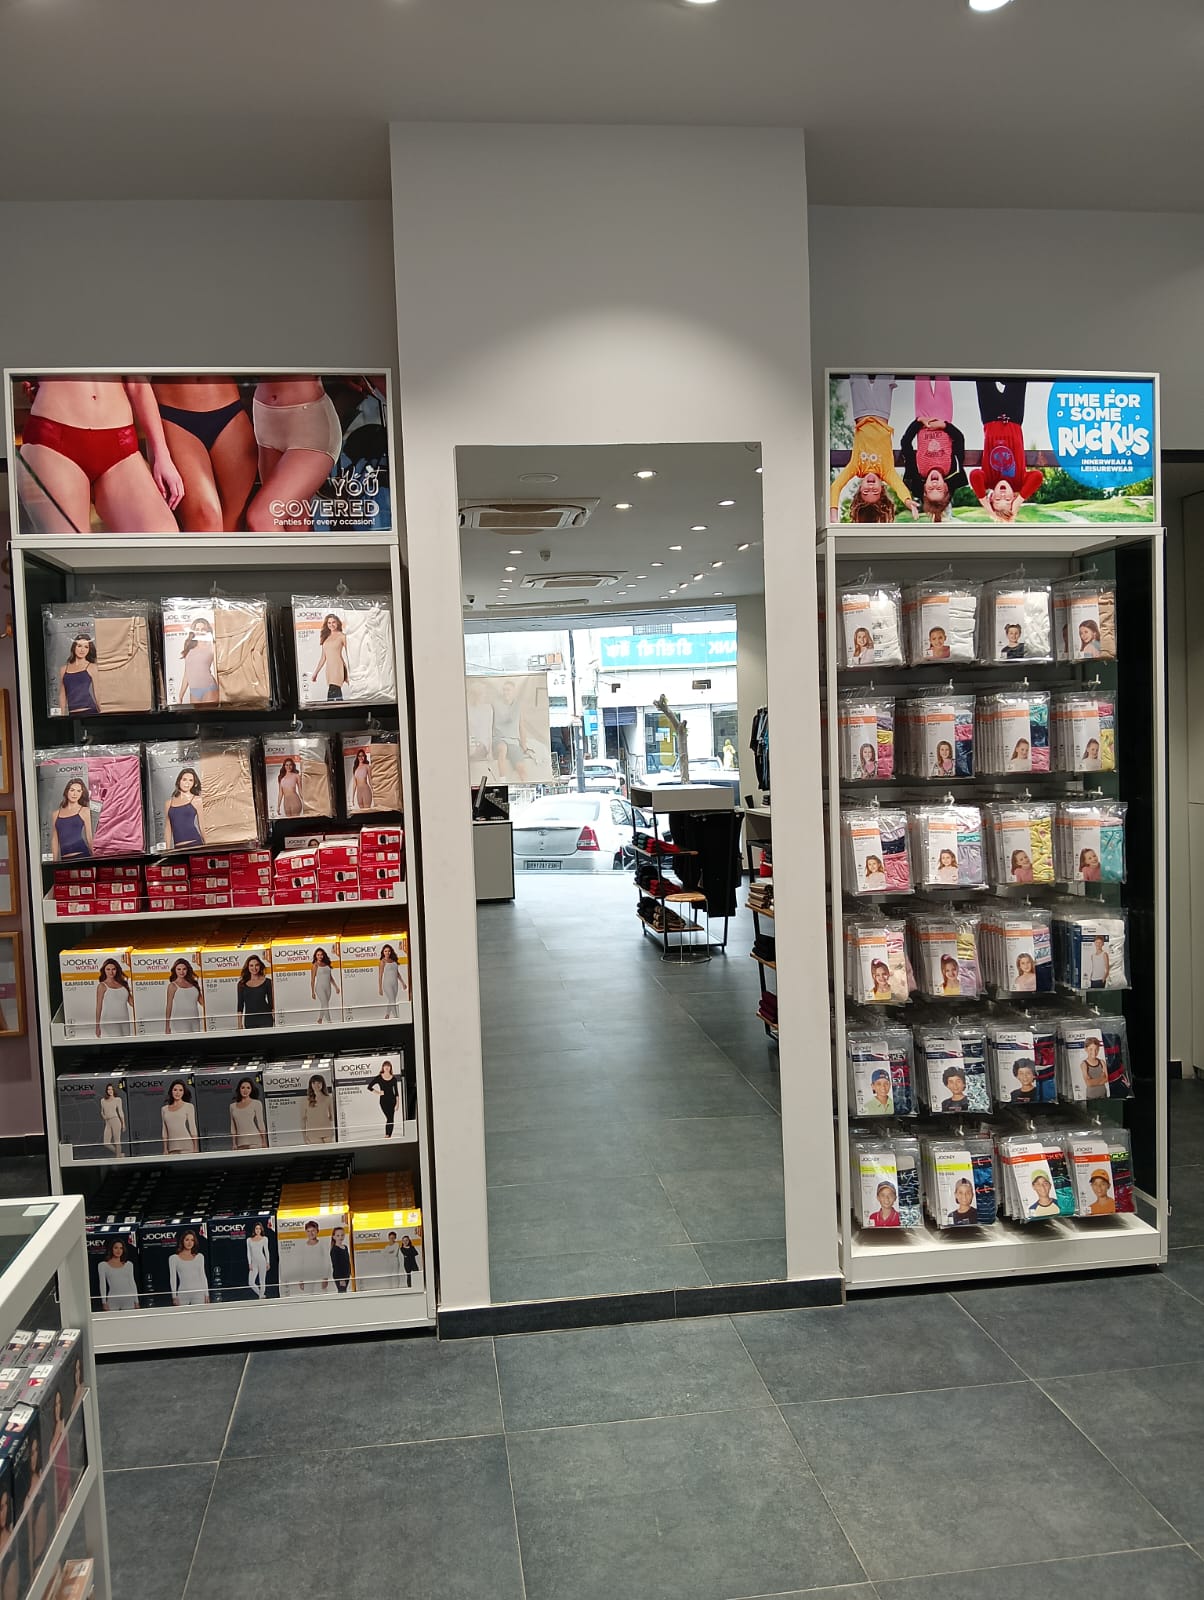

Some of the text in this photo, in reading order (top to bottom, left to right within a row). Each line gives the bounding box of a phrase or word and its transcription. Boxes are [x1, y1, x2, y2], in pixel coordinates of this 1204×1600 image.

[1057, 393, 1141, 408] TIME FOR
[1070, 407, 1121, 421] SOME
[1058, 421, 1150, 457] RUCKUS
[331, 479, 379, 496] YOU
[269, 499, 380, 517] COVERED
[273, 518, 376, 527] Panties for every occasion!
[274, 950, 309, 958] JOCKEY
[342, 946, 377, 954] JOCKEY
[63, 958, 98, 967] JOCKEY
[133, 958, 169, 966] JOCKEY
[204, 956, 240, 964] JOCKEY
[337, 1063, 371, 1072] JOCKEY
[129, 1080, 164, 1089] JOCKEY
[196, 1078, 232, 1087] JOCKEY
[265, 1076, 300, 1085] JOCKEY
[60, 1084, 95, 1092] JOCKEY
[211, 1224, 246, 1232] JOCKEY
[142, 1231, 177, 1240] JOCKEY
